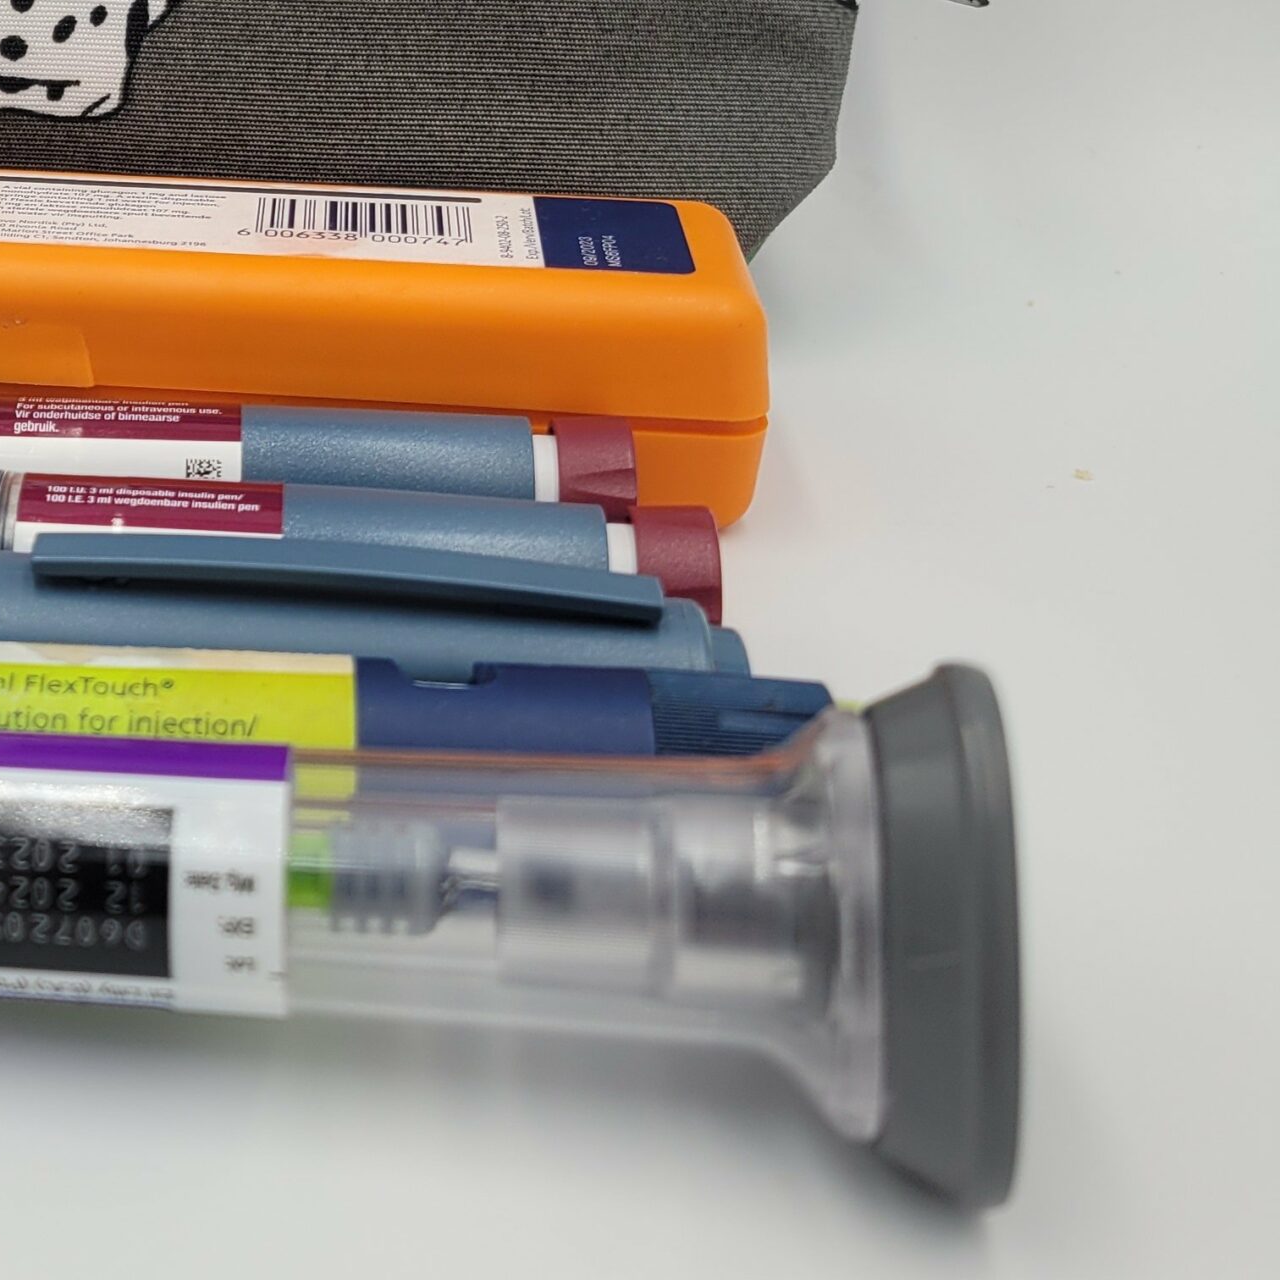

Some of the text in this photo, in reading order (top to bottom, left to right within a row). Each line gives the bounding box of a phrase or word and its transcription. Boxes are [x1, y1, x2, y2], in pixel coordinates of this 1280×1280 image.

[237, 228, 465, 246] 6 006338 000747
[578, 236, 598, 267] 09/2023
[15, 410, 30, 418] Vir
[33, 411, 101, 419] onderhuidse
[118, 413, 180, 422] binneaarse
[14, 421, 59, 434] gebruik.
[116, 488, 175, 497] disposable
[178, 491, 214, 499] insulin
[218, 493, 245, 501] pen/
[68, 495, 84, 503] I.E.
[98, 496, 111, 504] ml
[114, 497, 189, 507] wegdoenbare
[192, 501, 235, 509] insulien
[238, 504, 259, 512] pen
[78, 710, 120, 734] for
[129, 714, 257, 739] injection/
[104, 880, 144, 913] 12
